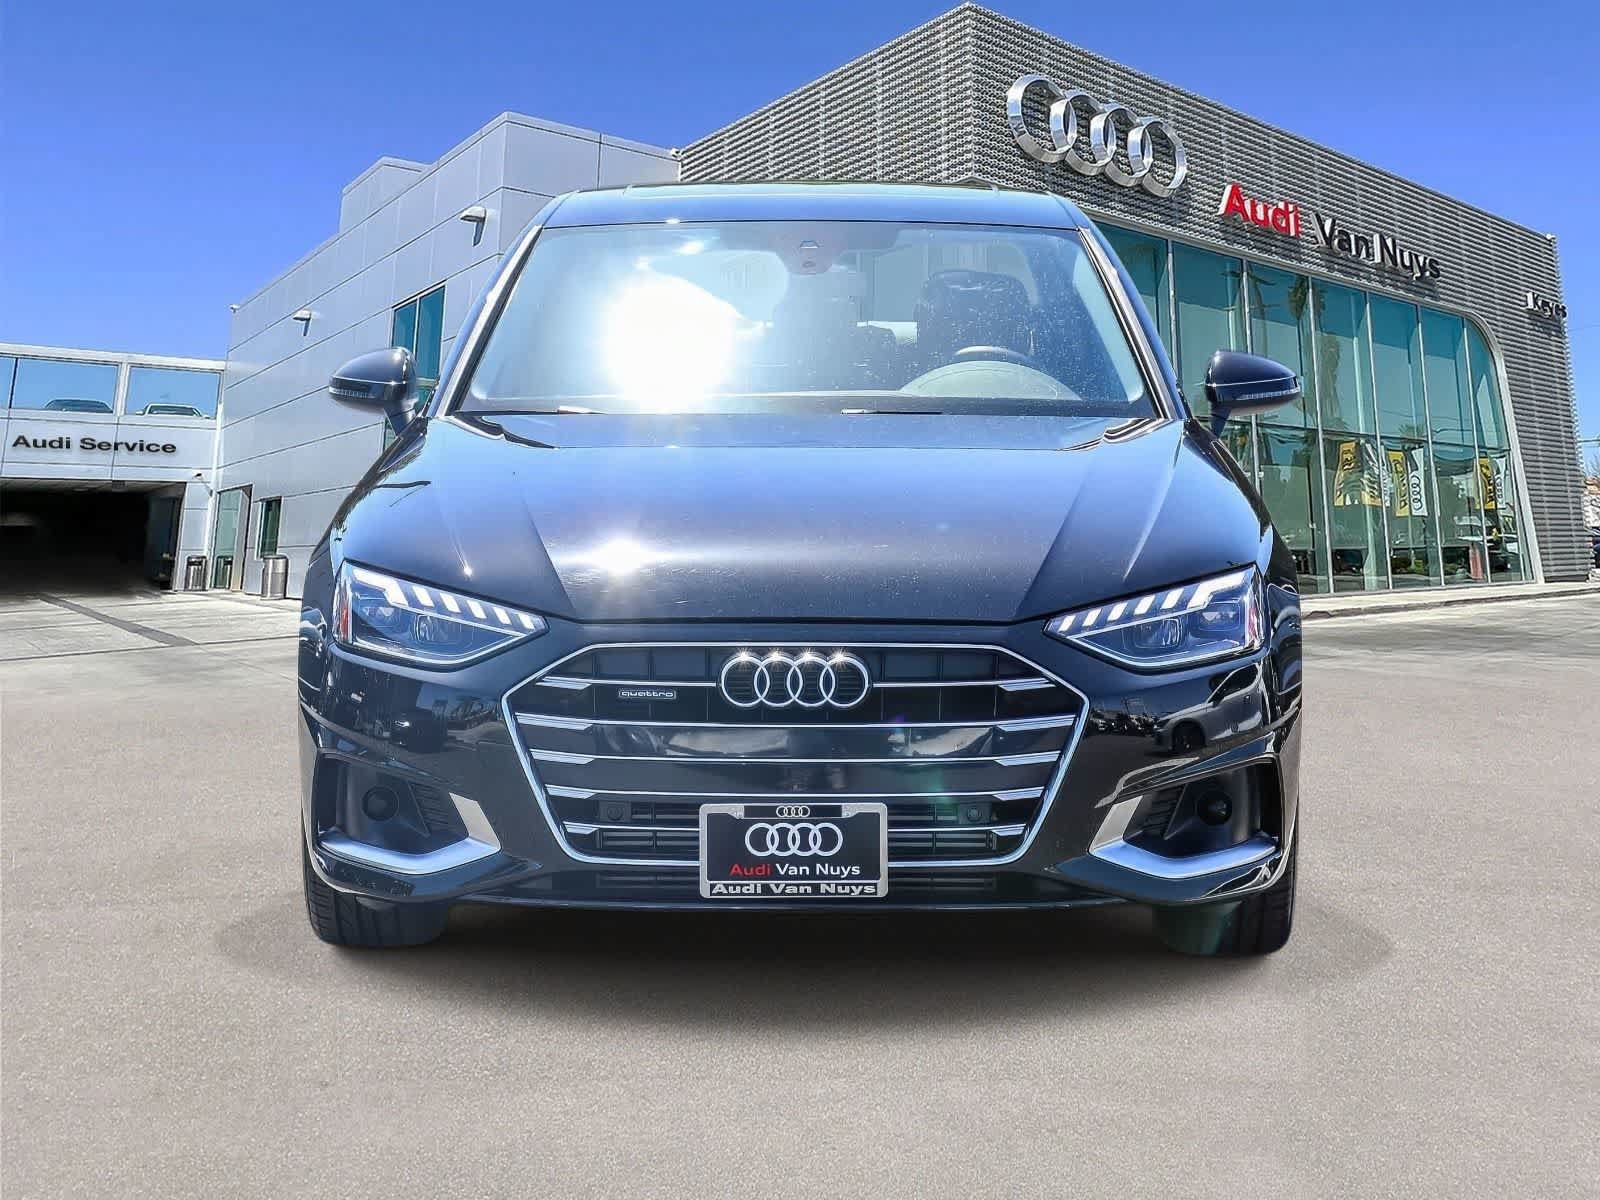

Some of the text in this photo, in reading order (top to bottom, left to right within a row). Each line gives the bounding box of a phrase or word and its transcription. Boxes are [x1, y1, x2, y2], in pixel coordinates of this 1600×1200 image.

[1218, 183, 1441, 281] Audi Van Nuys
[12, 435, 177, 453] Audi Service
[620, 690, 674, 698] quattro
[730, 863, 861, 878] Audi Van Nuys
[711, 883, 877, 895] Audi Van Nuys
